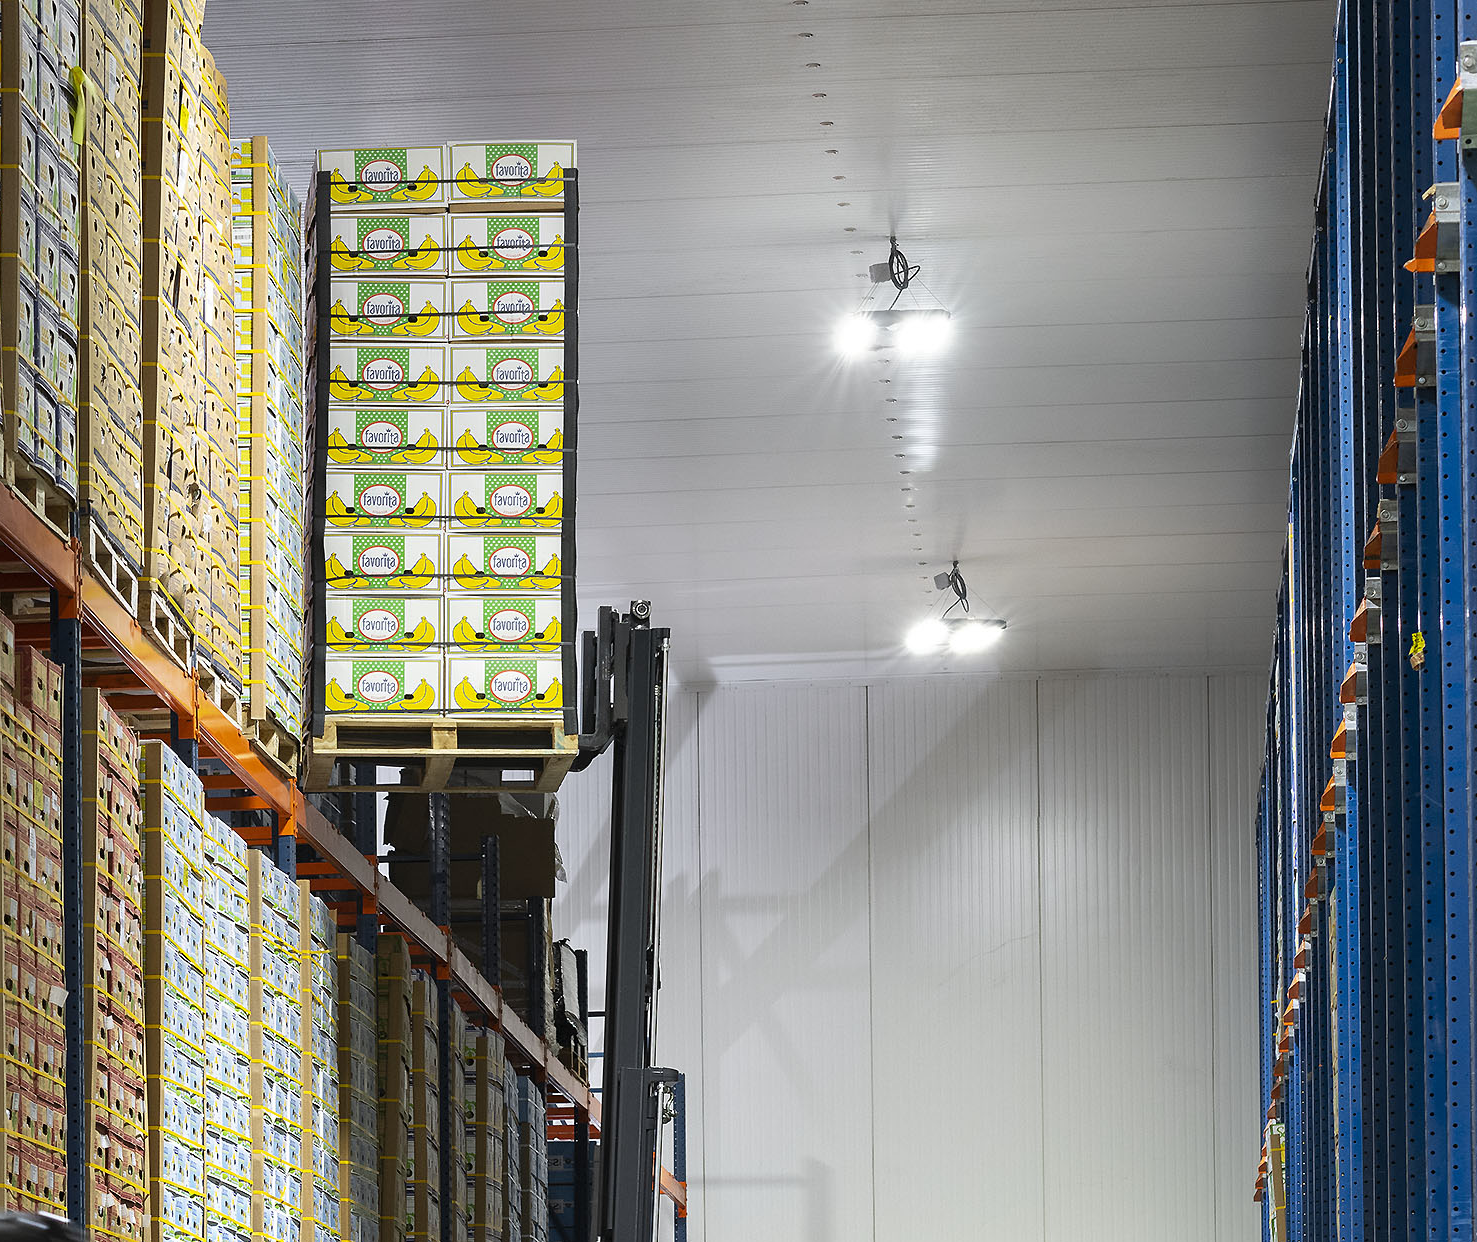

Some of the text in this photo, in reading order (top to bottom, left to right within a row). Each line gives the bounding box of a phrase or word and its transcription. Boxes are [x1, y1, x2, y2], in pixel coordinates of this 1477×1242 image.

[364, 167, 399, 183] favorita
[495, 162, 529, 177] favorita
[366, 236, 401, 251] favorita
[497, 236, 531, 251] favorita
[366, 301, 401, 316] favorita
[497, 300, 531, 315] favorita
[366, 366, 401, 381] favorita
[496, 366, 530, 382] favorita
[365, 429, 399, 444] favorita
[496, 429, 529, 444] favorita
[363, 492, 397, 508] favorita
[494, 492, 528, 508] favorita
[362, 554, 396, 570] favorita
[493, 554, 527, 570] favorita
[362, 617, 396, 632] favorita
[493, 617, 527, 632] favorita
[362, 678, 396, 694] favorita
[494, 677, 528, 693] favorita
